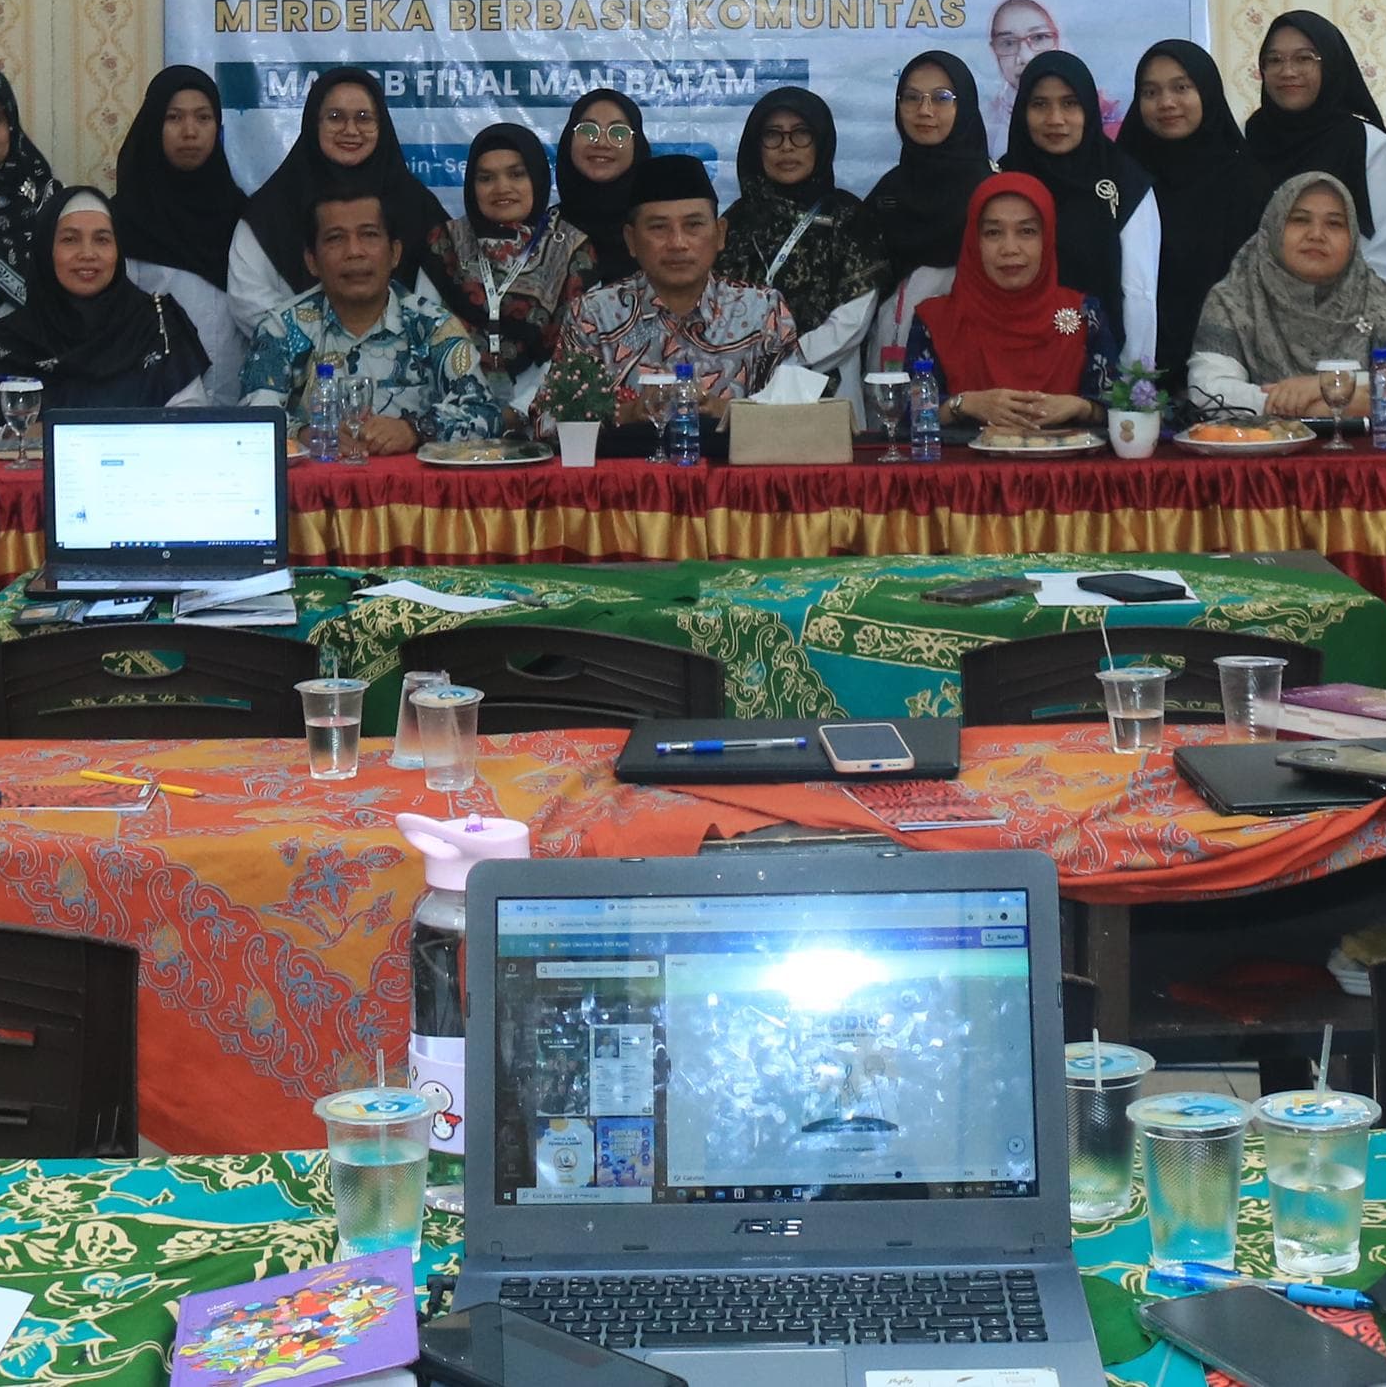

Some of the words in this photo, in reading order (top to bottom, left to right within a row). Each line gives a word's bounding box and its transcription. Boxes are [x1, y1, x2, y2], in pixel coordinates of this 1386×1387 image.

[416, 69, 519, 97] FILIAL
[530, 68, 614, 96] MAN
[625, 67, 756, 95] BATAM
[733, 1219, 803, 1236] ASUS
